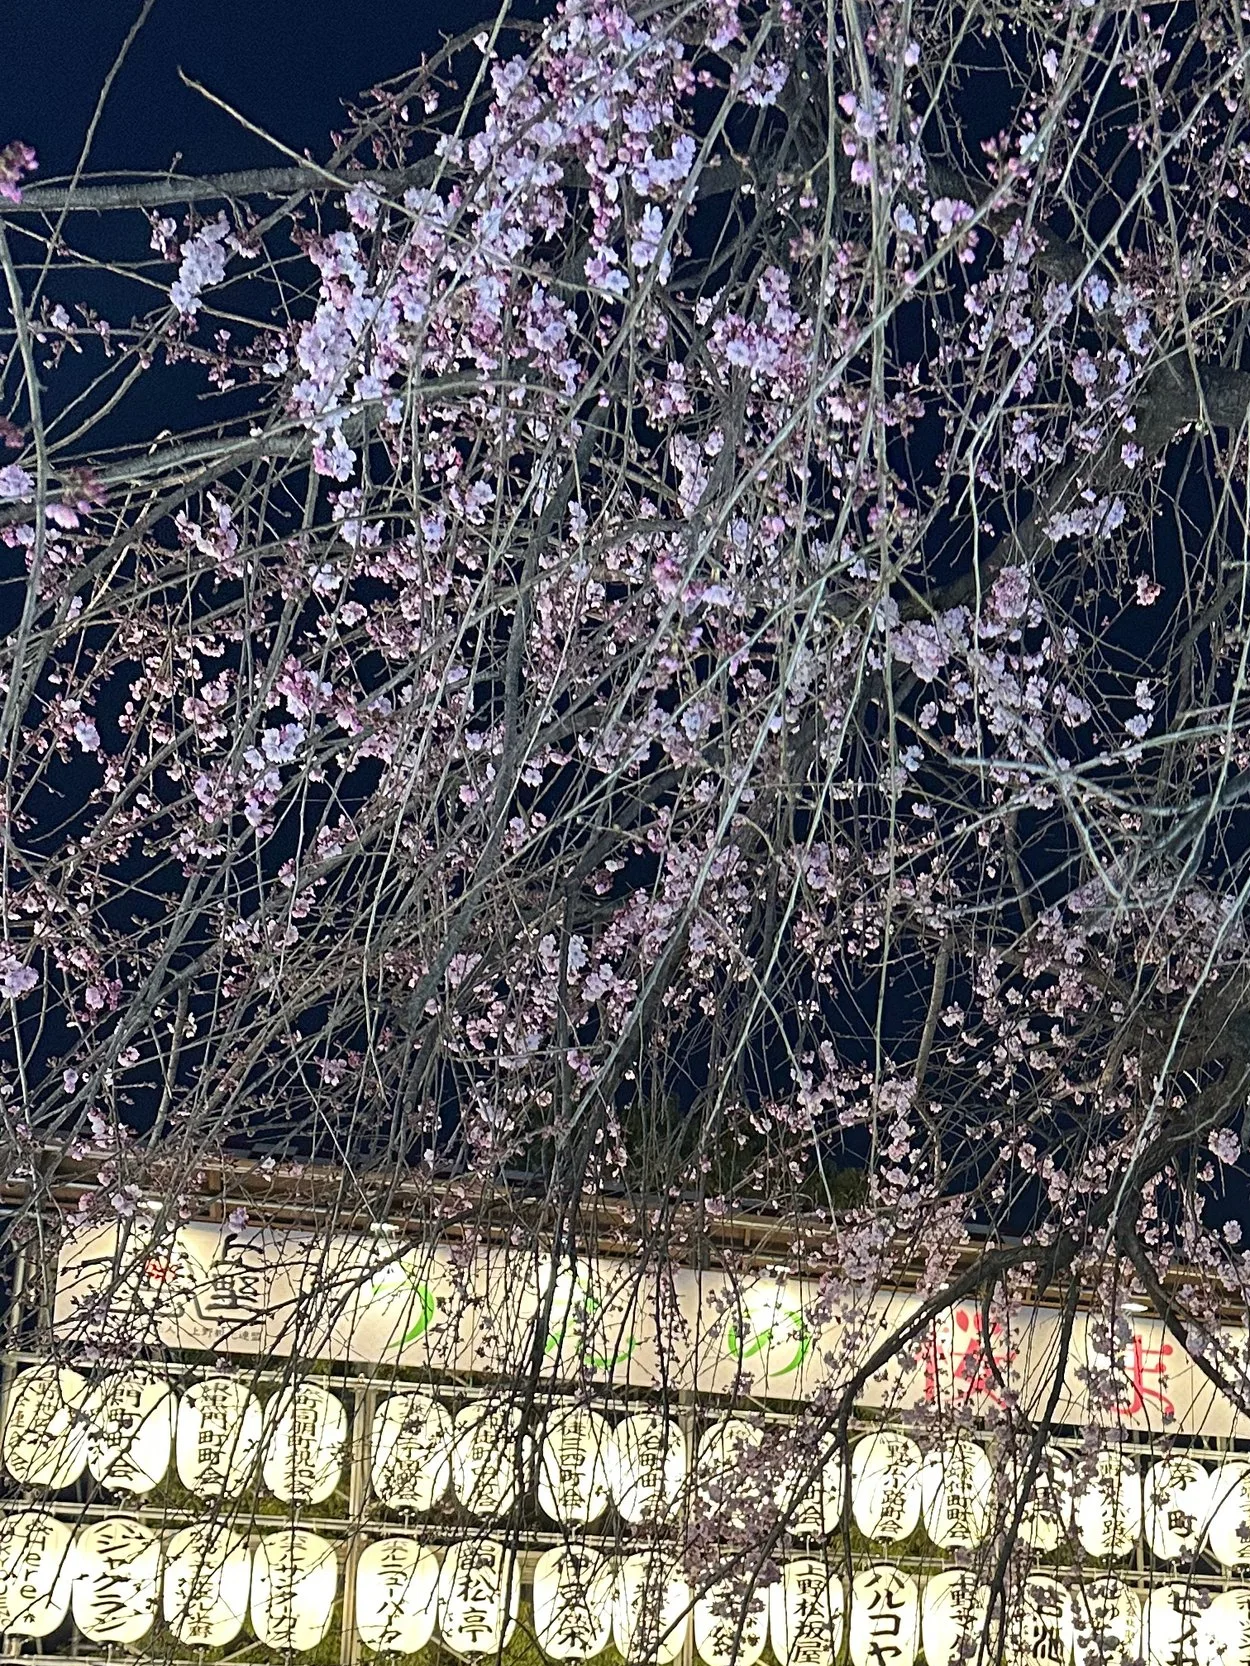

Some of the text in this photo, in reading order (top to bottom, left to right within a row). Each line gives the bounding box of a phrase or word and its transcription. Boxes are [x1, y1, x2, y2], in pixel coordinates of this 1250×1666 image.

[792, 1564, 828, 1664] 上野松坂屋
